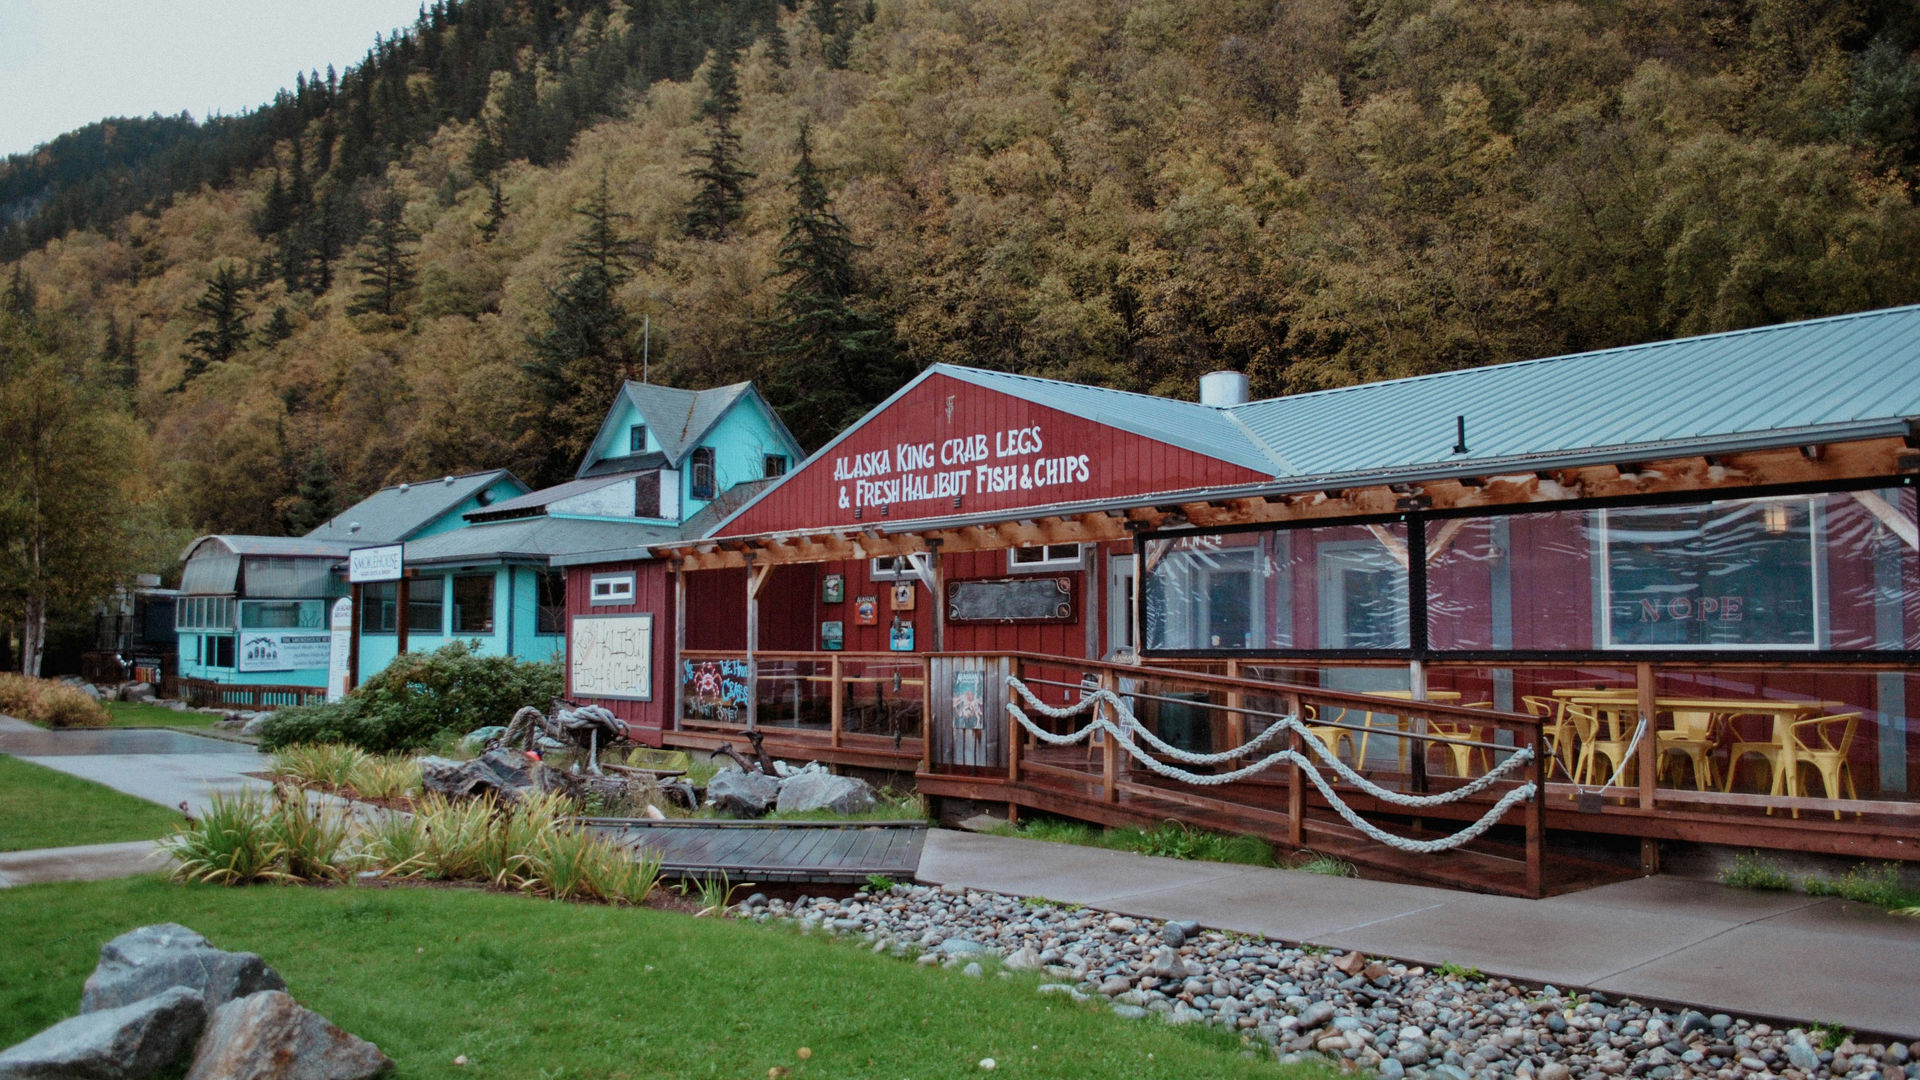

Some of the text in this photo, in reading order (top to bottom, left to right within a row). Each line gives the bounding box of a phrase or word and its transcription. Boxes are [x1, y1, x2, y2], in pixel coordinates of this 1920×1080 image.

[834, 425, 1043, 481] ALASKA KING CRAB LEGS
[838, 454, 1090, 509] & FRESH HALIBUT FISH & CHIPS
[1640, 596, 1743, 622] NOPE
